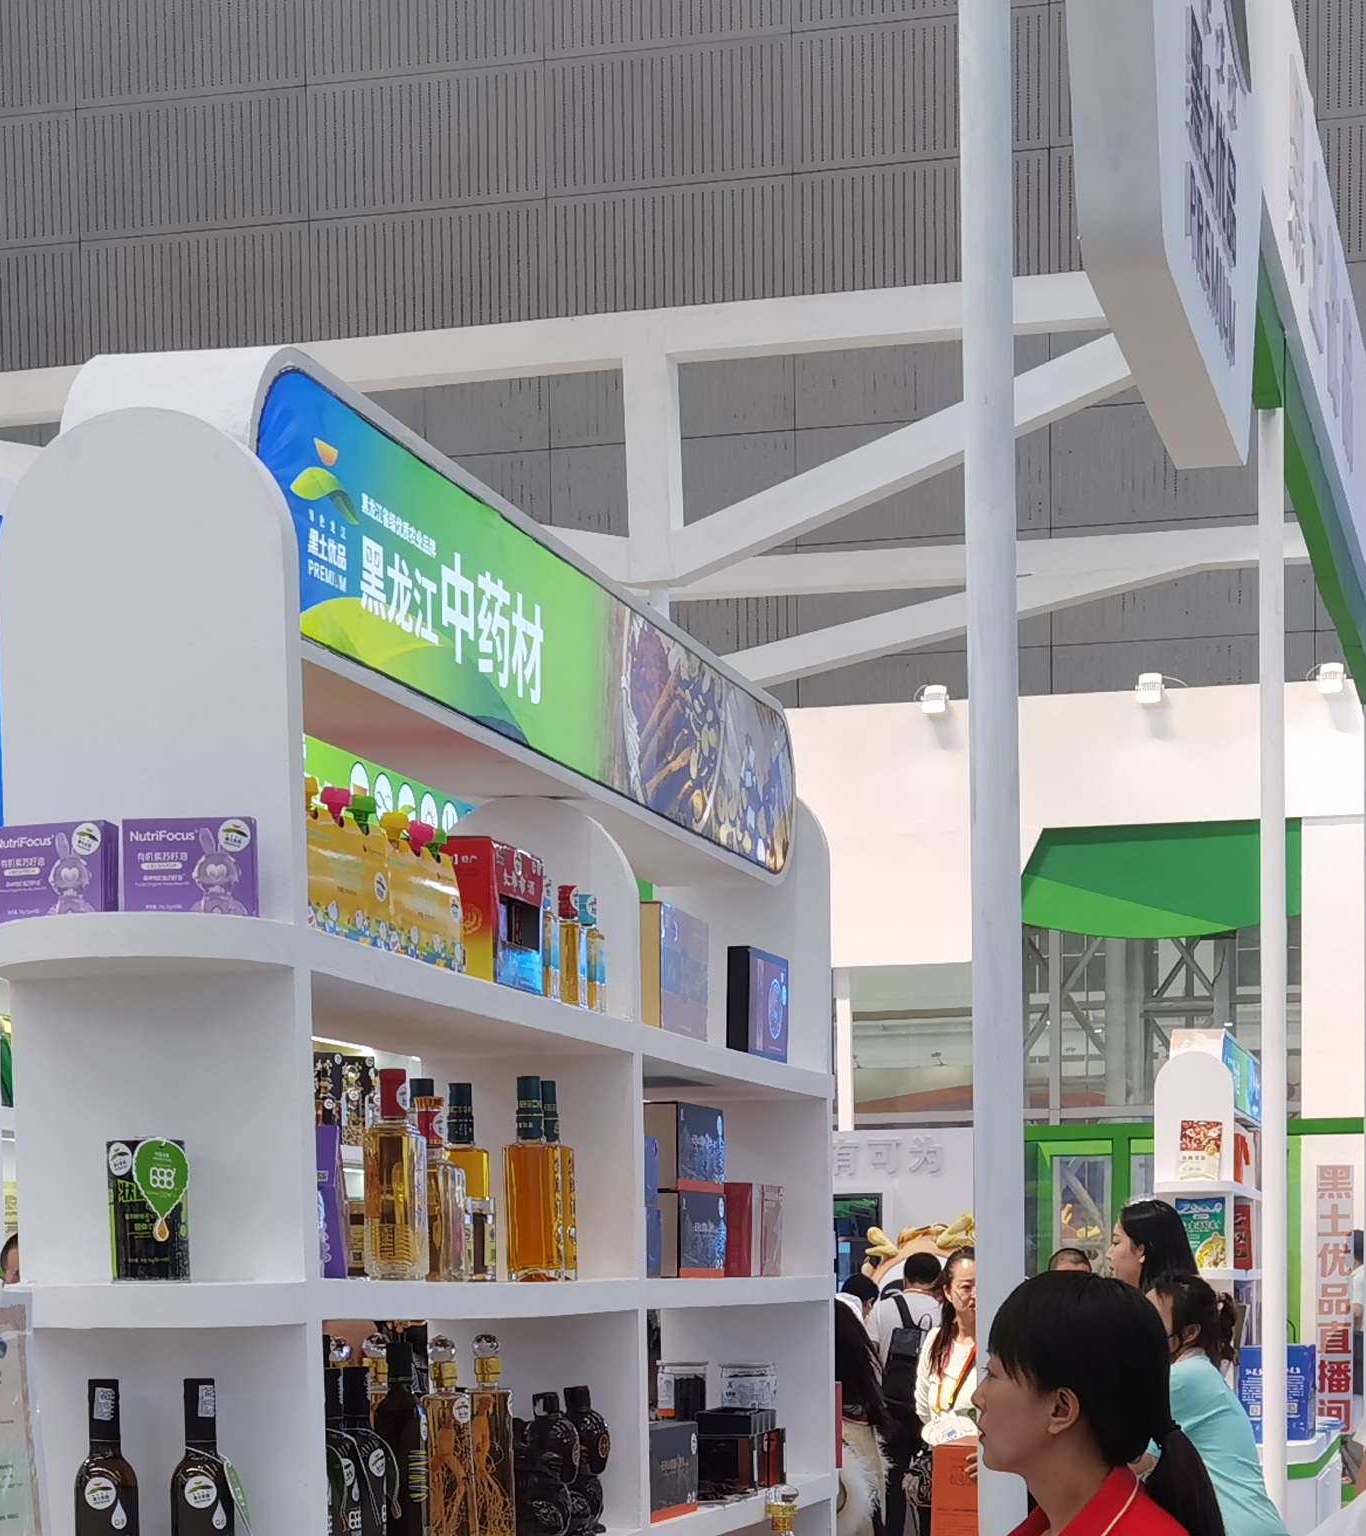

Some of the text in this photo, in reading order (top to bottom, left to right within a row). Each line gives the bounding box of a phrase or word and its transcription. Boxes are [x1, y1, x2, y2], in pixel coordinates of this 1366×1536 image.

[1186, 162, 1236, 368] PREMIUM
[307, 528, 347, 571] 黑土优品
[129, 829, 196, 843] NutriFocus
[1317, 1164, 1352, 1433] 黑土优品直播间
